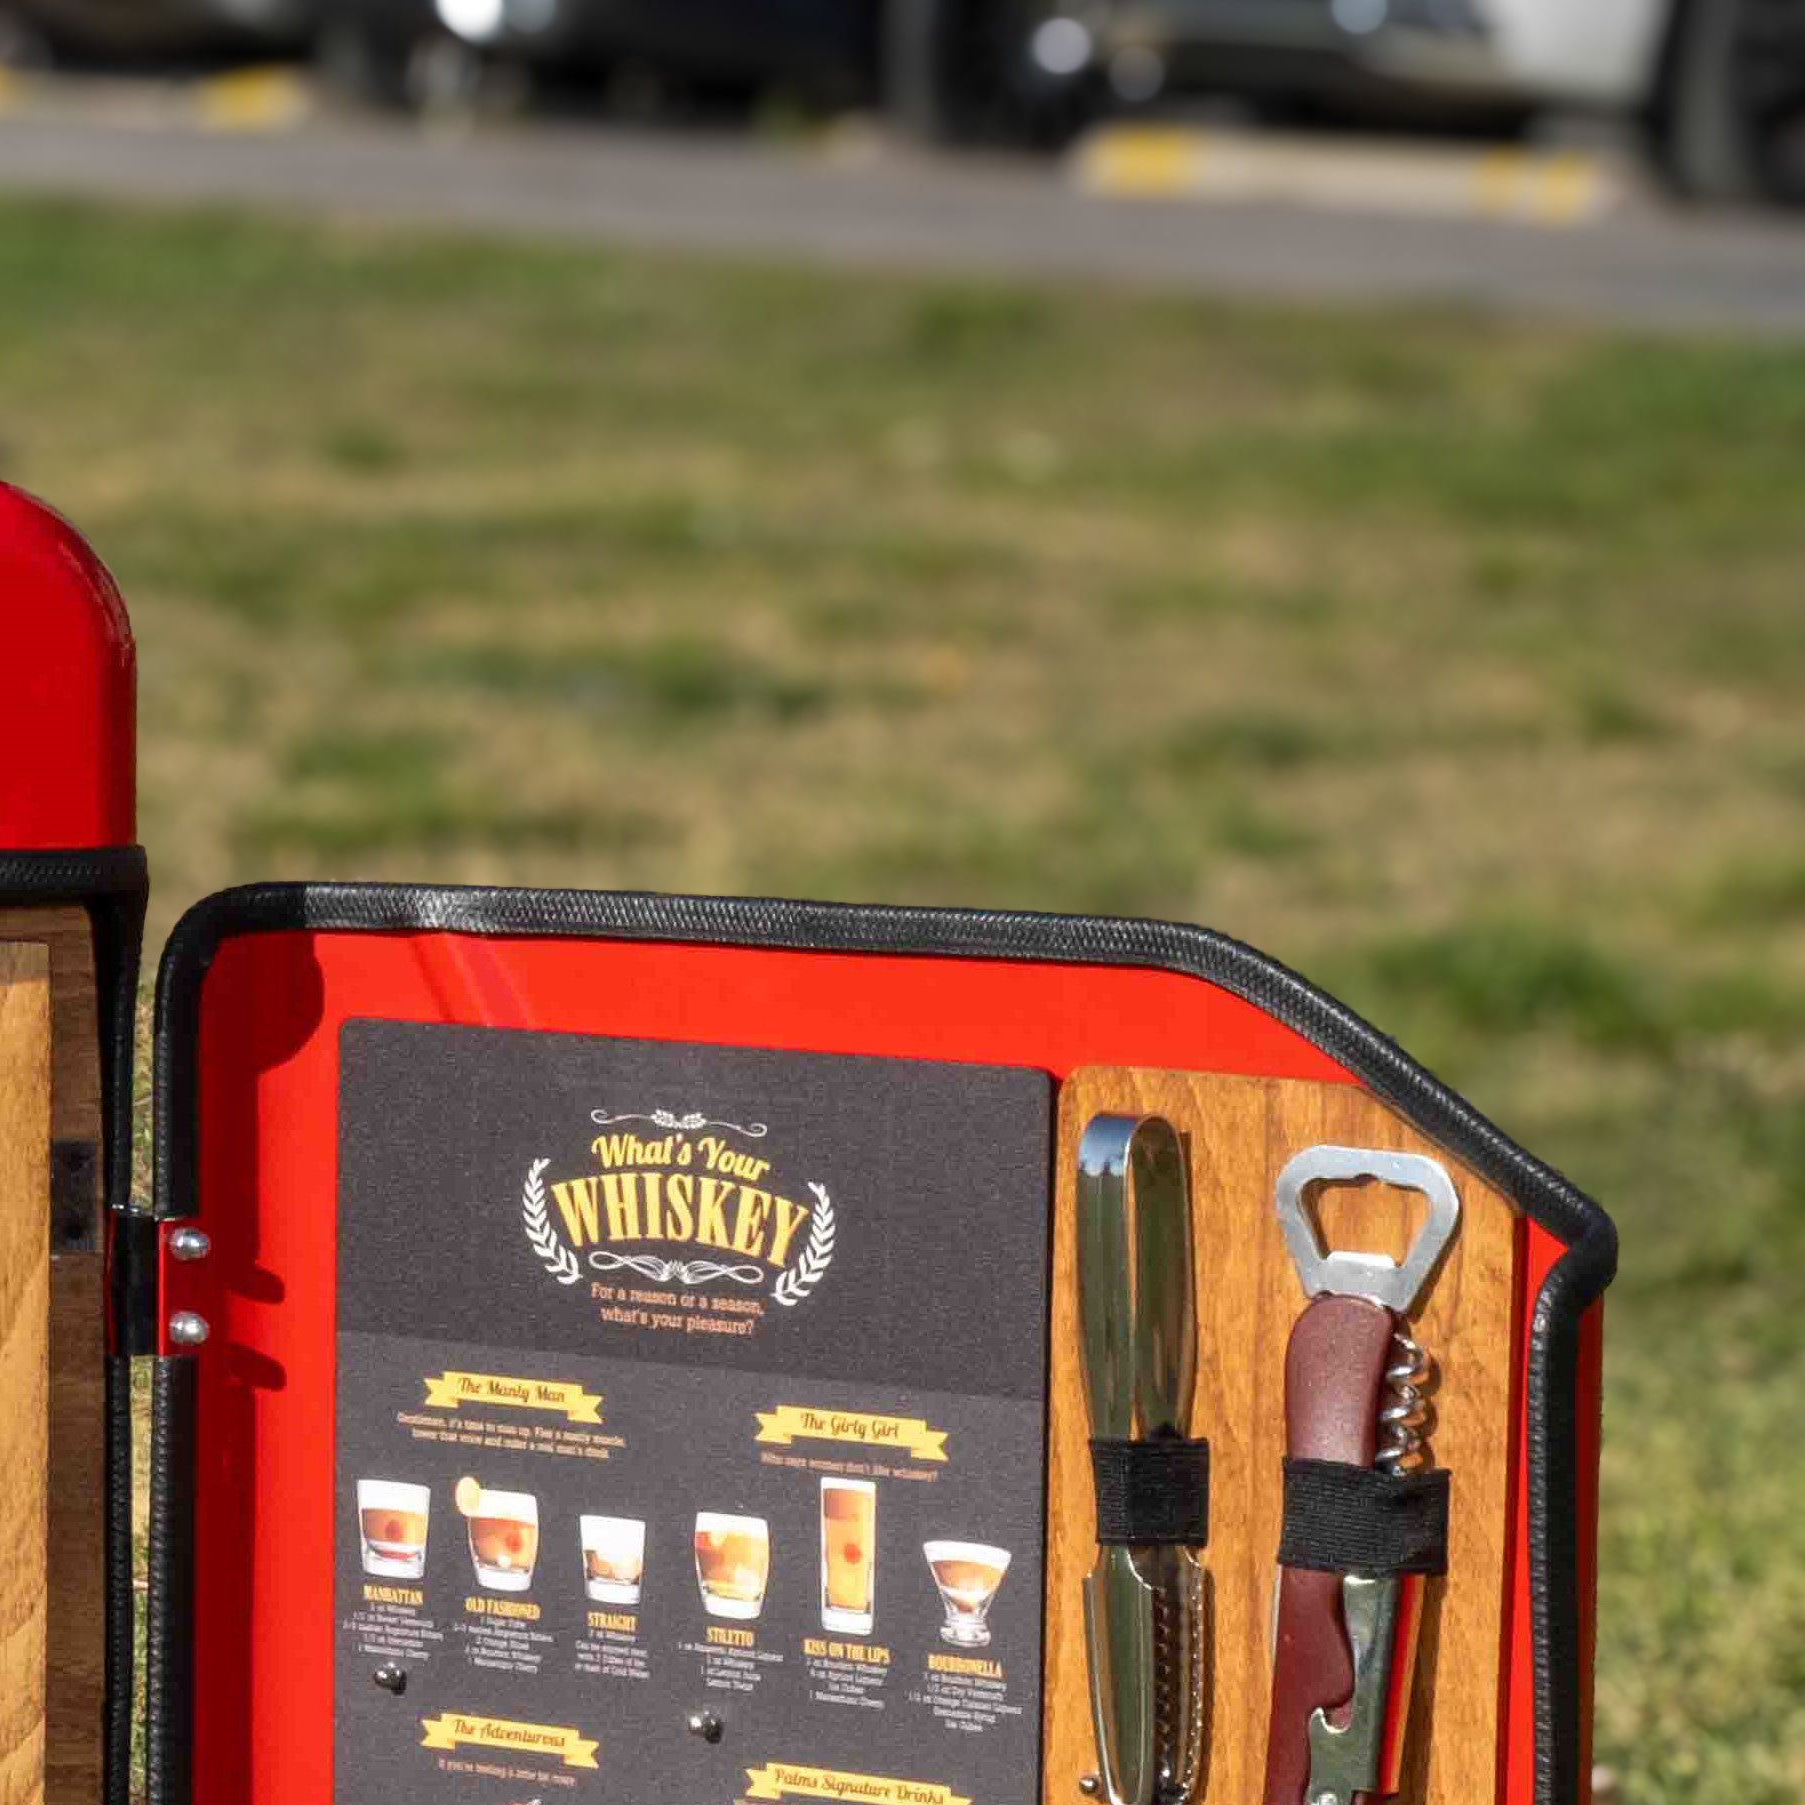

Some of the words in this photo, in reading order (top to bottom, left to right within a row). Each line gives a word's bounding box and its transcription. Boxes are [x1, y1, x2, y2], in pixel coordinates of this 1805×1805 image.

[591, 1133, 692, 1168] What's
[698, 1137, 770, 1181] Your
[551, 1172, 810, 1268] WHISKEY
[591, 1282, 613, 1299] For
[617, 1288, 626, 1300] a
[631, 1289, 677, 1306] reason
[680, 1293, 696, 1308] or
[600, 1306, 648, 1324] what's
[651, 1312, 683, 1328] your
[686, 1315, 755, 1335] pleasure?
[458, 1377, 481, 1394] The
[487, 1379, 530, 1402] Manly
[537, 1384, 565, 1403] Man
[800, 1412, 825, 1430] The
[831, 1417, 866, 1438] Girly
[871, 1419, 899, 1437] Girl
[363, 1584, 424, 1605] MANHATTAN
[464, 1597, 485, 1615] OLD
[587, 1611, 637, 1631] STRAIGHT
[706, 1626, 755, 1647] STILETTO
[454, 1718, 475, 1735] The
[480, 1722, 565, 1747] Adventurous
[774, 1768, 817, 1789] Palms
[821, 1774, 891, 1797] Signature
[896, 1785, 945, 1805] Drinks
